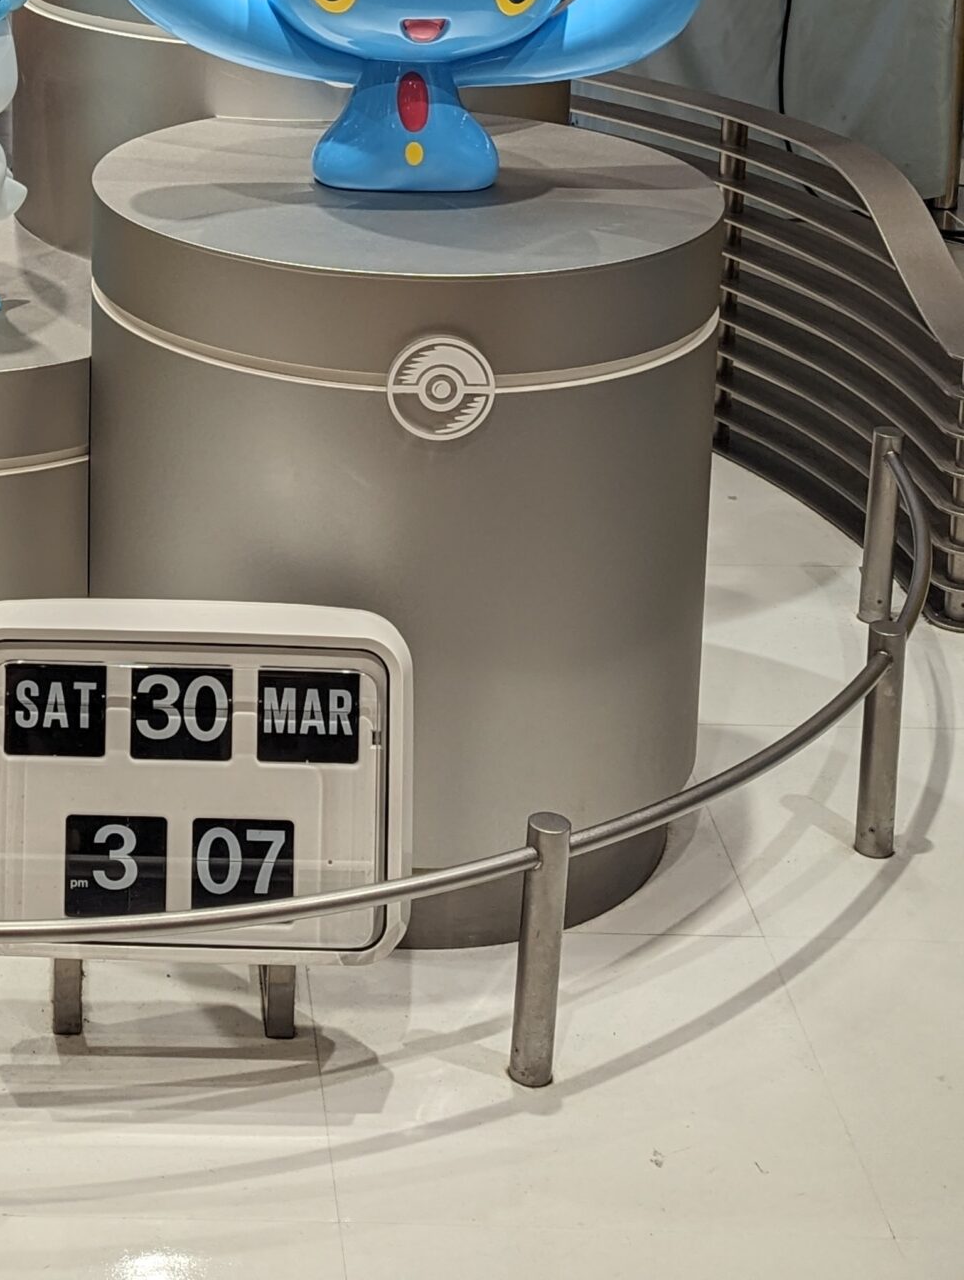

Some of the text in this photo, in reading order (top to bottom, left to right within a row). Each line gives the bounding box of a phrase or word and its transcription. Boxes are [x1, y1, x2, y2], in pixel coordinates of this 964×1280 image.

[14, 674, 353, 742] SAT 30 MAR
[70, 824, 286, 894] pm 3 07
